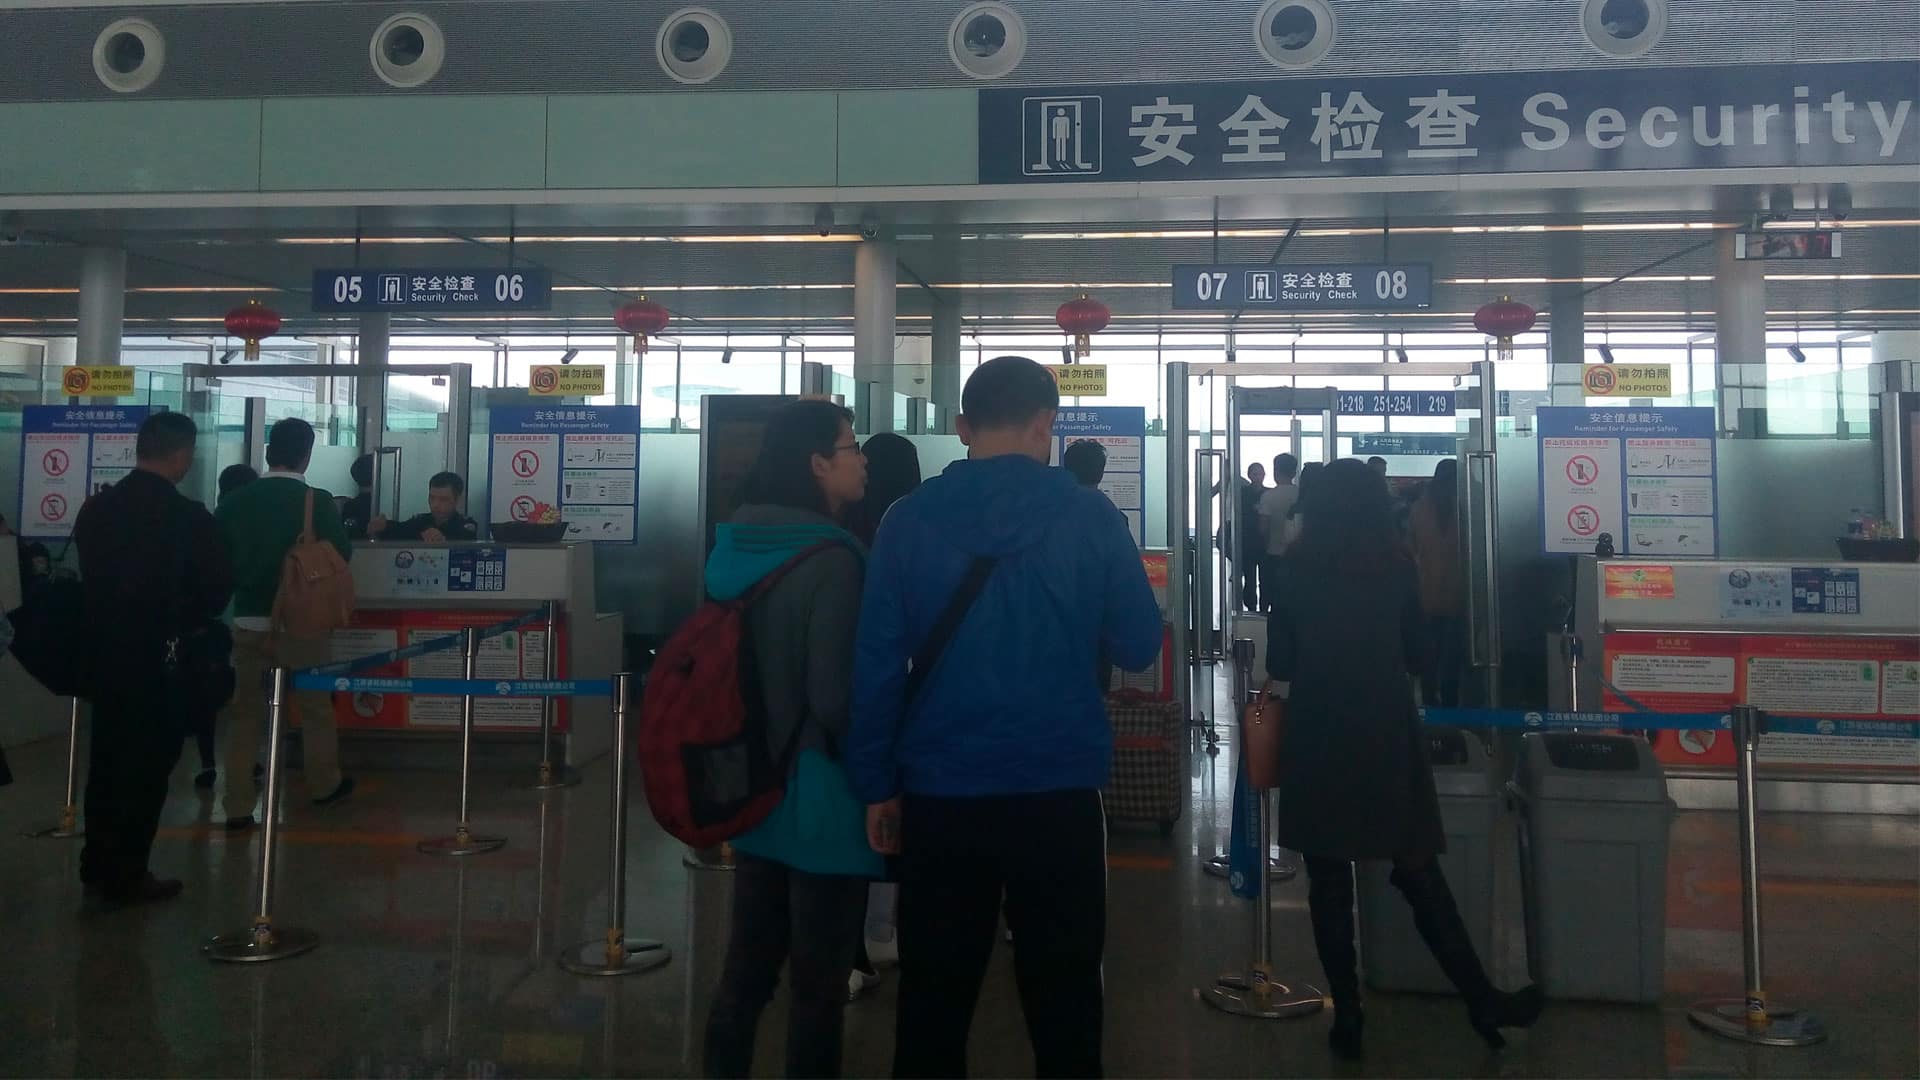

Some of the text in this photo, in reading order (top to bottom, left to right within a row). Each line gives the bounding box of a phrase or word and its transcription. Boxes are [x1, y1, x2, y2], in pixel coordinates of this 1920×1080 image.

[1521, 85, 1912, 157] Security
[1128, 88, 1481, 168] 安全检查
[411, 275, 476, 291] 安全检查
[1282, 272, 1353, 288] 安全检查
[1375, 270, 1408, 300] 08
[333, 276, 363, 303] 05
[495, 274, 524, 302] 06
[1196, 272, 1228, 301] 07
[411, 292, 479, 303] Security Check
[1281, 289, 1358, 301] Security Check
[559, 368, 603, 379] 请勿拍照
[1059, 368, 1105, 379] 请勿拍照
[1618, 368, 1669, 379] 请勿拍照
[1619, 384, 1669, 392] NO PHOTOS
[1336, 395, 1447, 413] 1-218 251-254 219
[535, 411, 597, 421] 安全信息提示
[1590, 412, 1664, 423] 安全信息提示
[1092, 423, 1112, 431] Safety
[1620, 425, 1656, 433] Passenger
[1657, 425, 1679, 433] Safety
